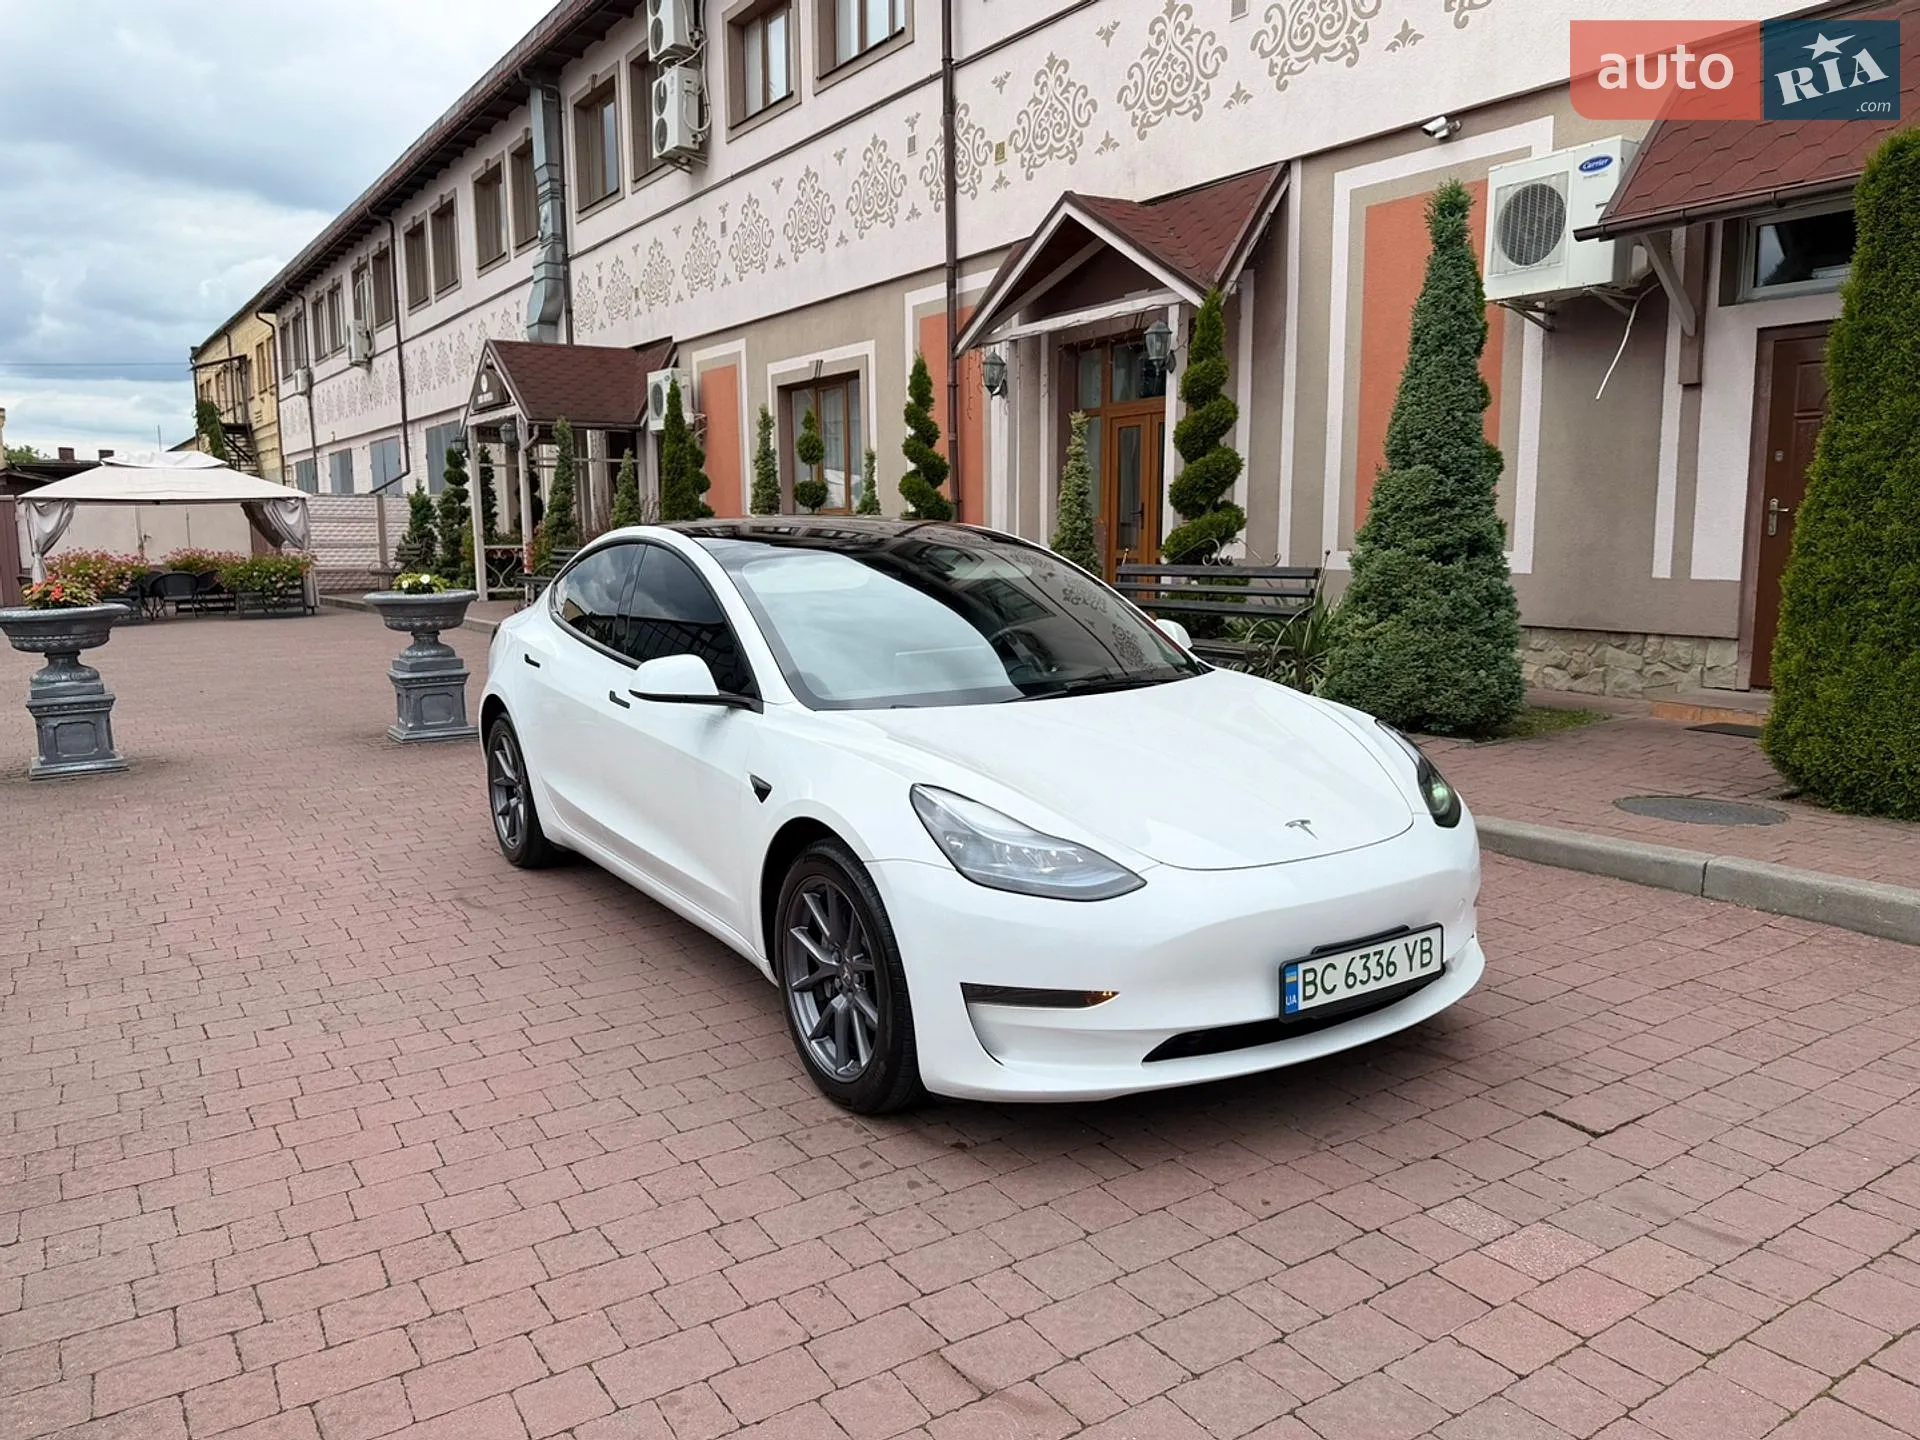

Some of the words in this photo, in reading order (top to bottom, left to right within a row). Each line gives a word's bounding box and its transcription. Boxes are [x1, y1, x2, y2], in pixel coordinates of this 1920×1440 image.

[1302, 963, 1337, 1001] BC
[1344, 945, 1398, 990] 6336
[1404, 936, 1434, 972] YB
[1285, 993, 1297, 1006] UA
